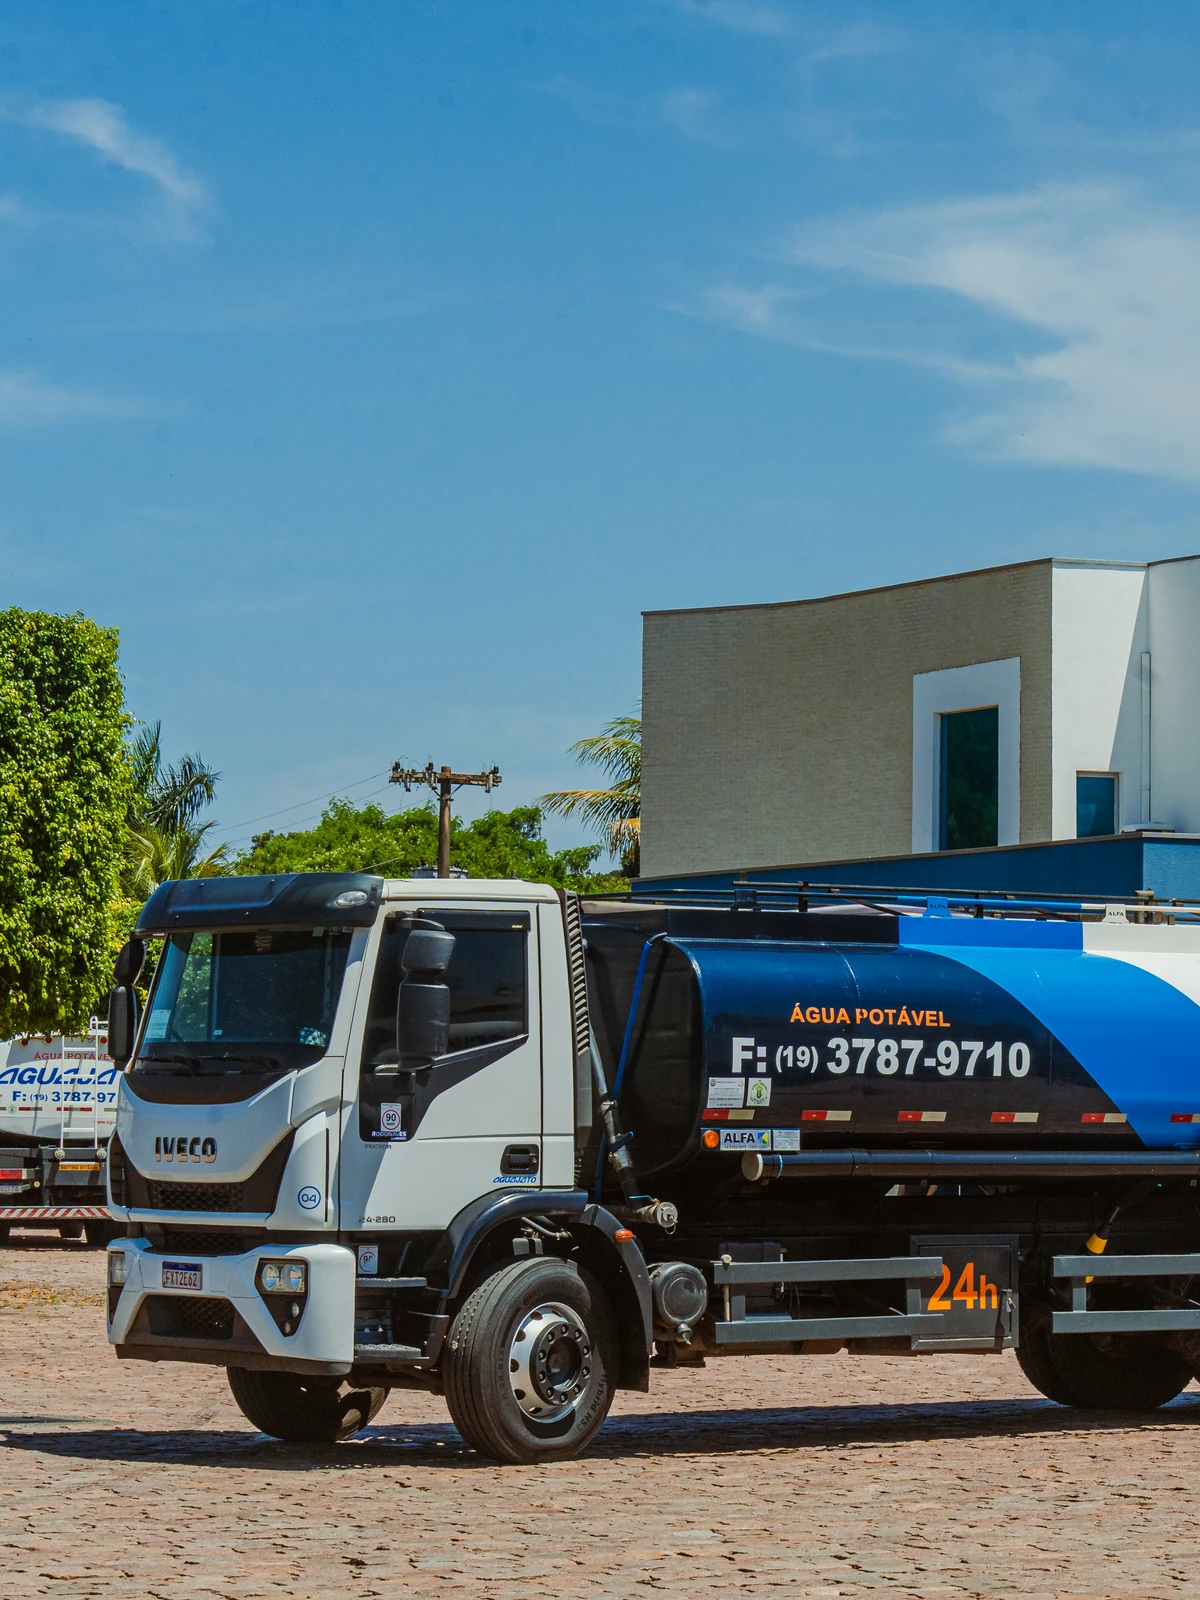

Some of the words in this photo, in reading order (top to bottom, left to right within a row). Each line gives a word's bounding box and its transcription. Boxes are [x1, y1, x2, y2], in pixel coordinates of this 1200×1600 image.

[789, 1002, 851, 1024] ÁGUA
[855, 1005, 951, 1028] POTÁVEL
[67, 1051, 114, 1061] POTÁVE
[731, 1036, 767, 1074] F:
[775, 1045, 819, 1074] (19)
[826, 1036, 1031, 1078] 3787-9710
[12, 1091, 27, 1101] F:
[30, 1094, 48, 1102] (19)
[51, 1091, 117, 1103] 3787-97
[385, 1113, 397, 1122] 90
[723, 1132, 756, 1143] ALFA
[155, 1136, 218, 1164] IVECO
[301, 1193, 317, 1203] 04
[165, 1270, 198, 1287] FXT2E62
[927, 1262, 998, 1311] 24h
